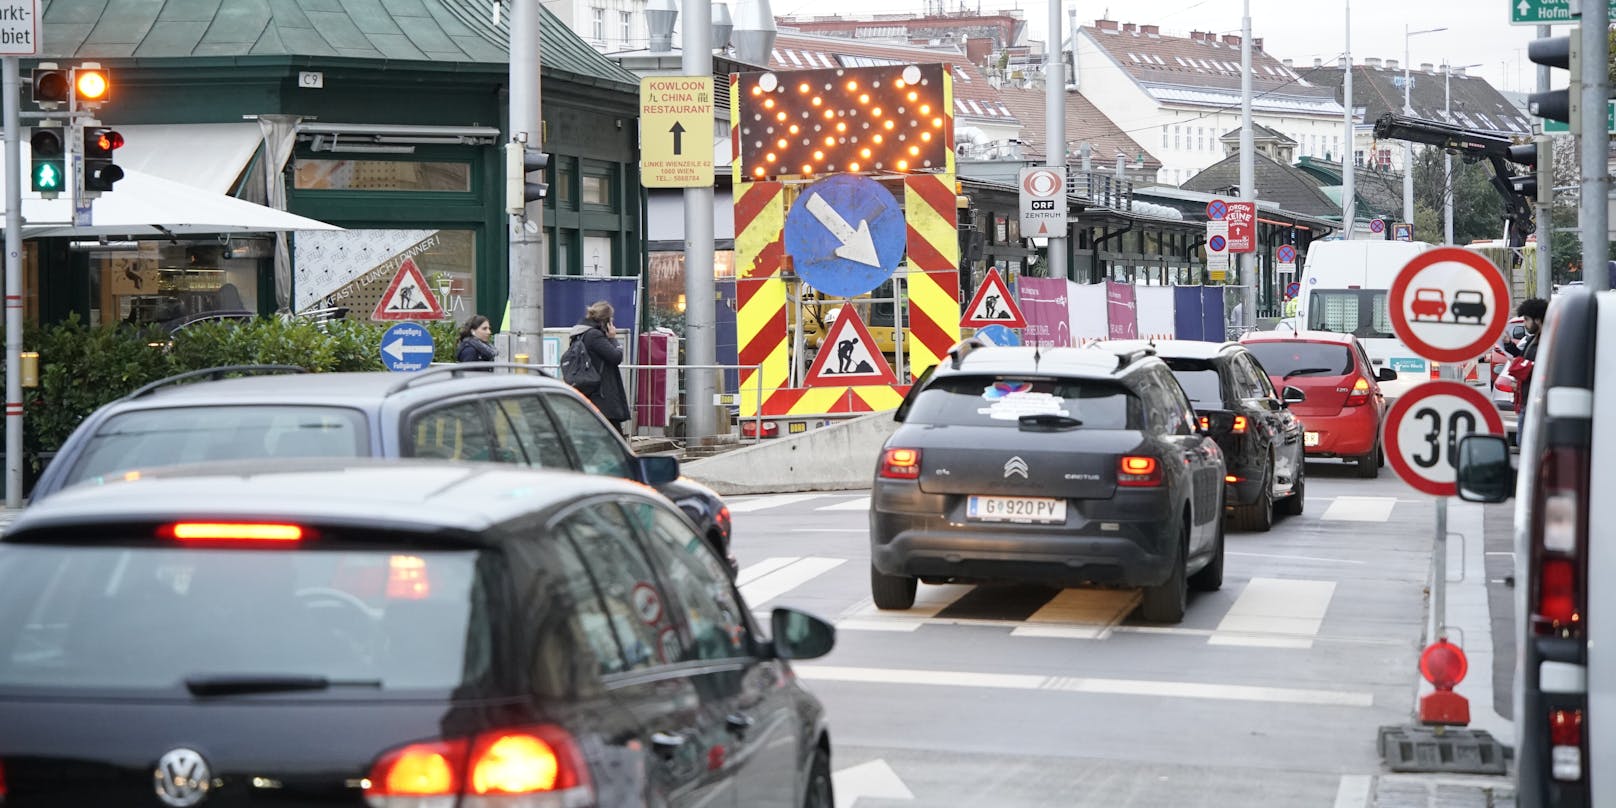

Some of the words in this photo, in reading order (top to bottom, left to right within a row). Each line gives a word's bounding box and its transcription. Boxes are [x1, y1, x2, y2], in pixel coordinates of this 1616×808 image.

[649, 82, 705, 91] KOWLOON
[661, 93, 693, 102] CHINA
[643, 105, 711, 114] RESTAURANT
[1225, 212, 1252, 222] KEINE
[361, 262, 394, 286] LUNCH
[400, 239, 435, 262] DINNER
[1412, 407, 1476, 469] 30
[987, 500, 995, 514] G
[1006, 500, 1034, 515] 920
[1037, 500, 1056, 515] PV
